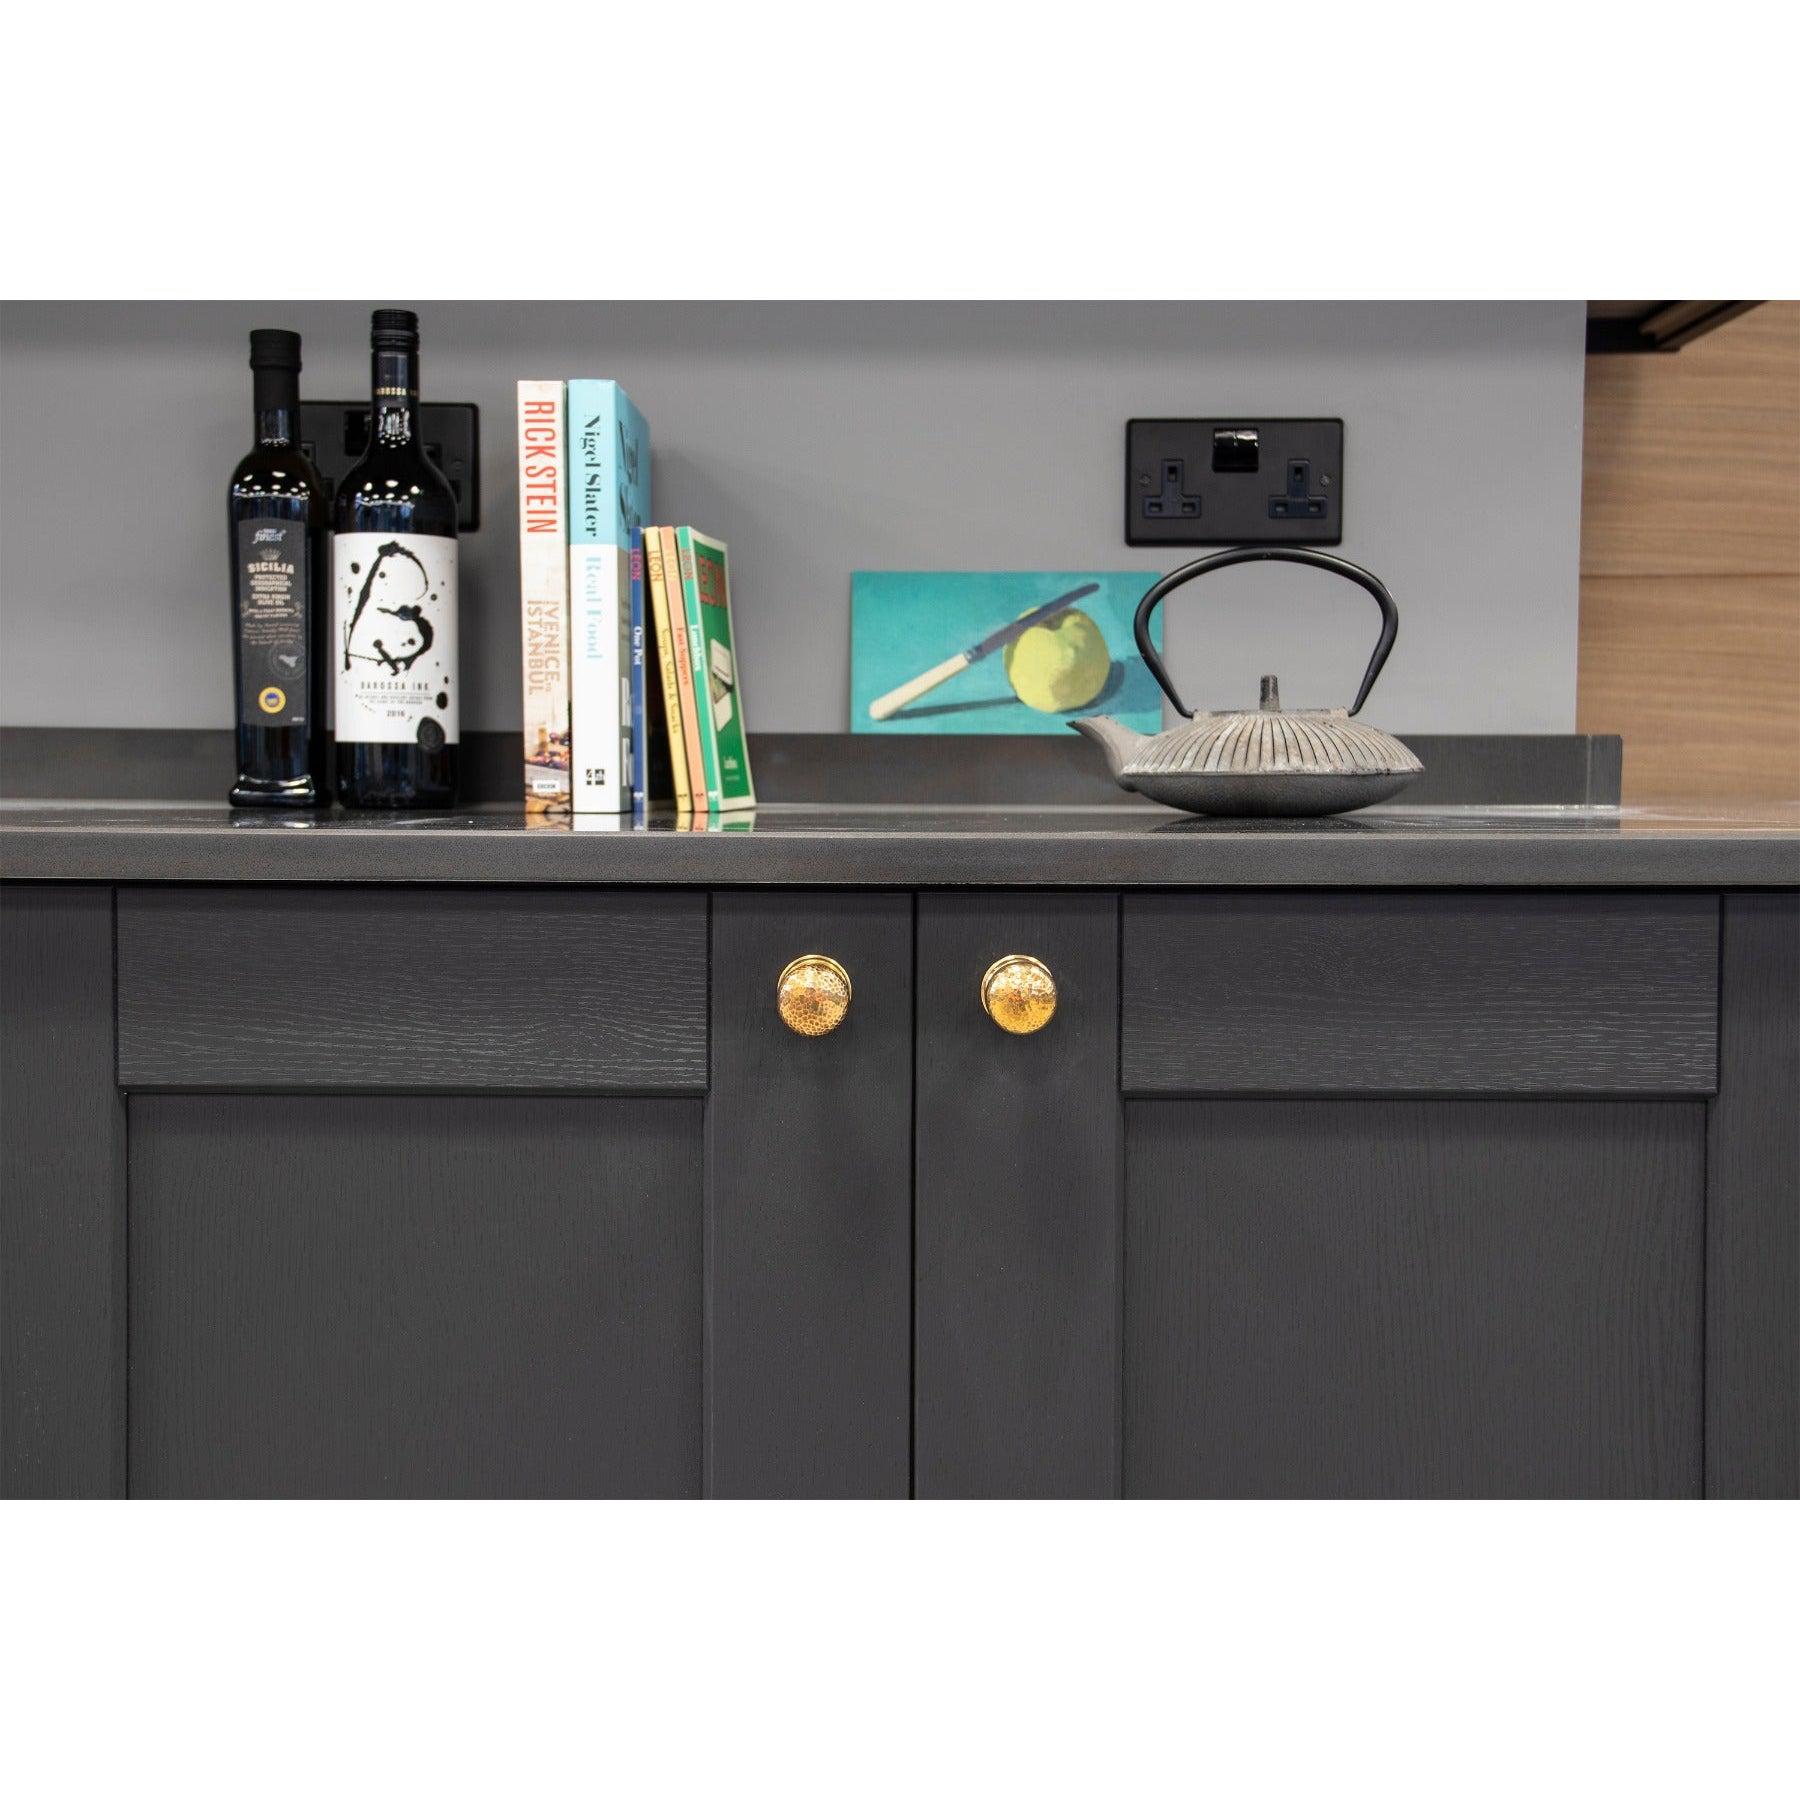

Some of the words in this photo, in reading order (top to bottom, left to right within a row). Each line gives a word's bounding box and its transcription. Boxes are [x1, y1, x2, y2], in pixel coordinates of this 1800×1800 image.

[524, 401, 556, 459] RICK
[580, 414, 601, 468] Nigel
[525, 465, 557, 533] STEIN
[585, 473, 601, 537] Slater
[247, 562, 295, 574] SICILIA
[586, 556, 602, 602] Real
[648, 551, 663, 582] LEON
[528, 600, 544, 695] ISTANBUL
[544, 606, 560, 682] VENICE
[587, 609, 603, 659] Food
[633, 625, 643, 647] One
[633, 648, 643, 666] Pot
[677, 627, 685, 645] Fast
[679, 649, 689, 685] Suppers
